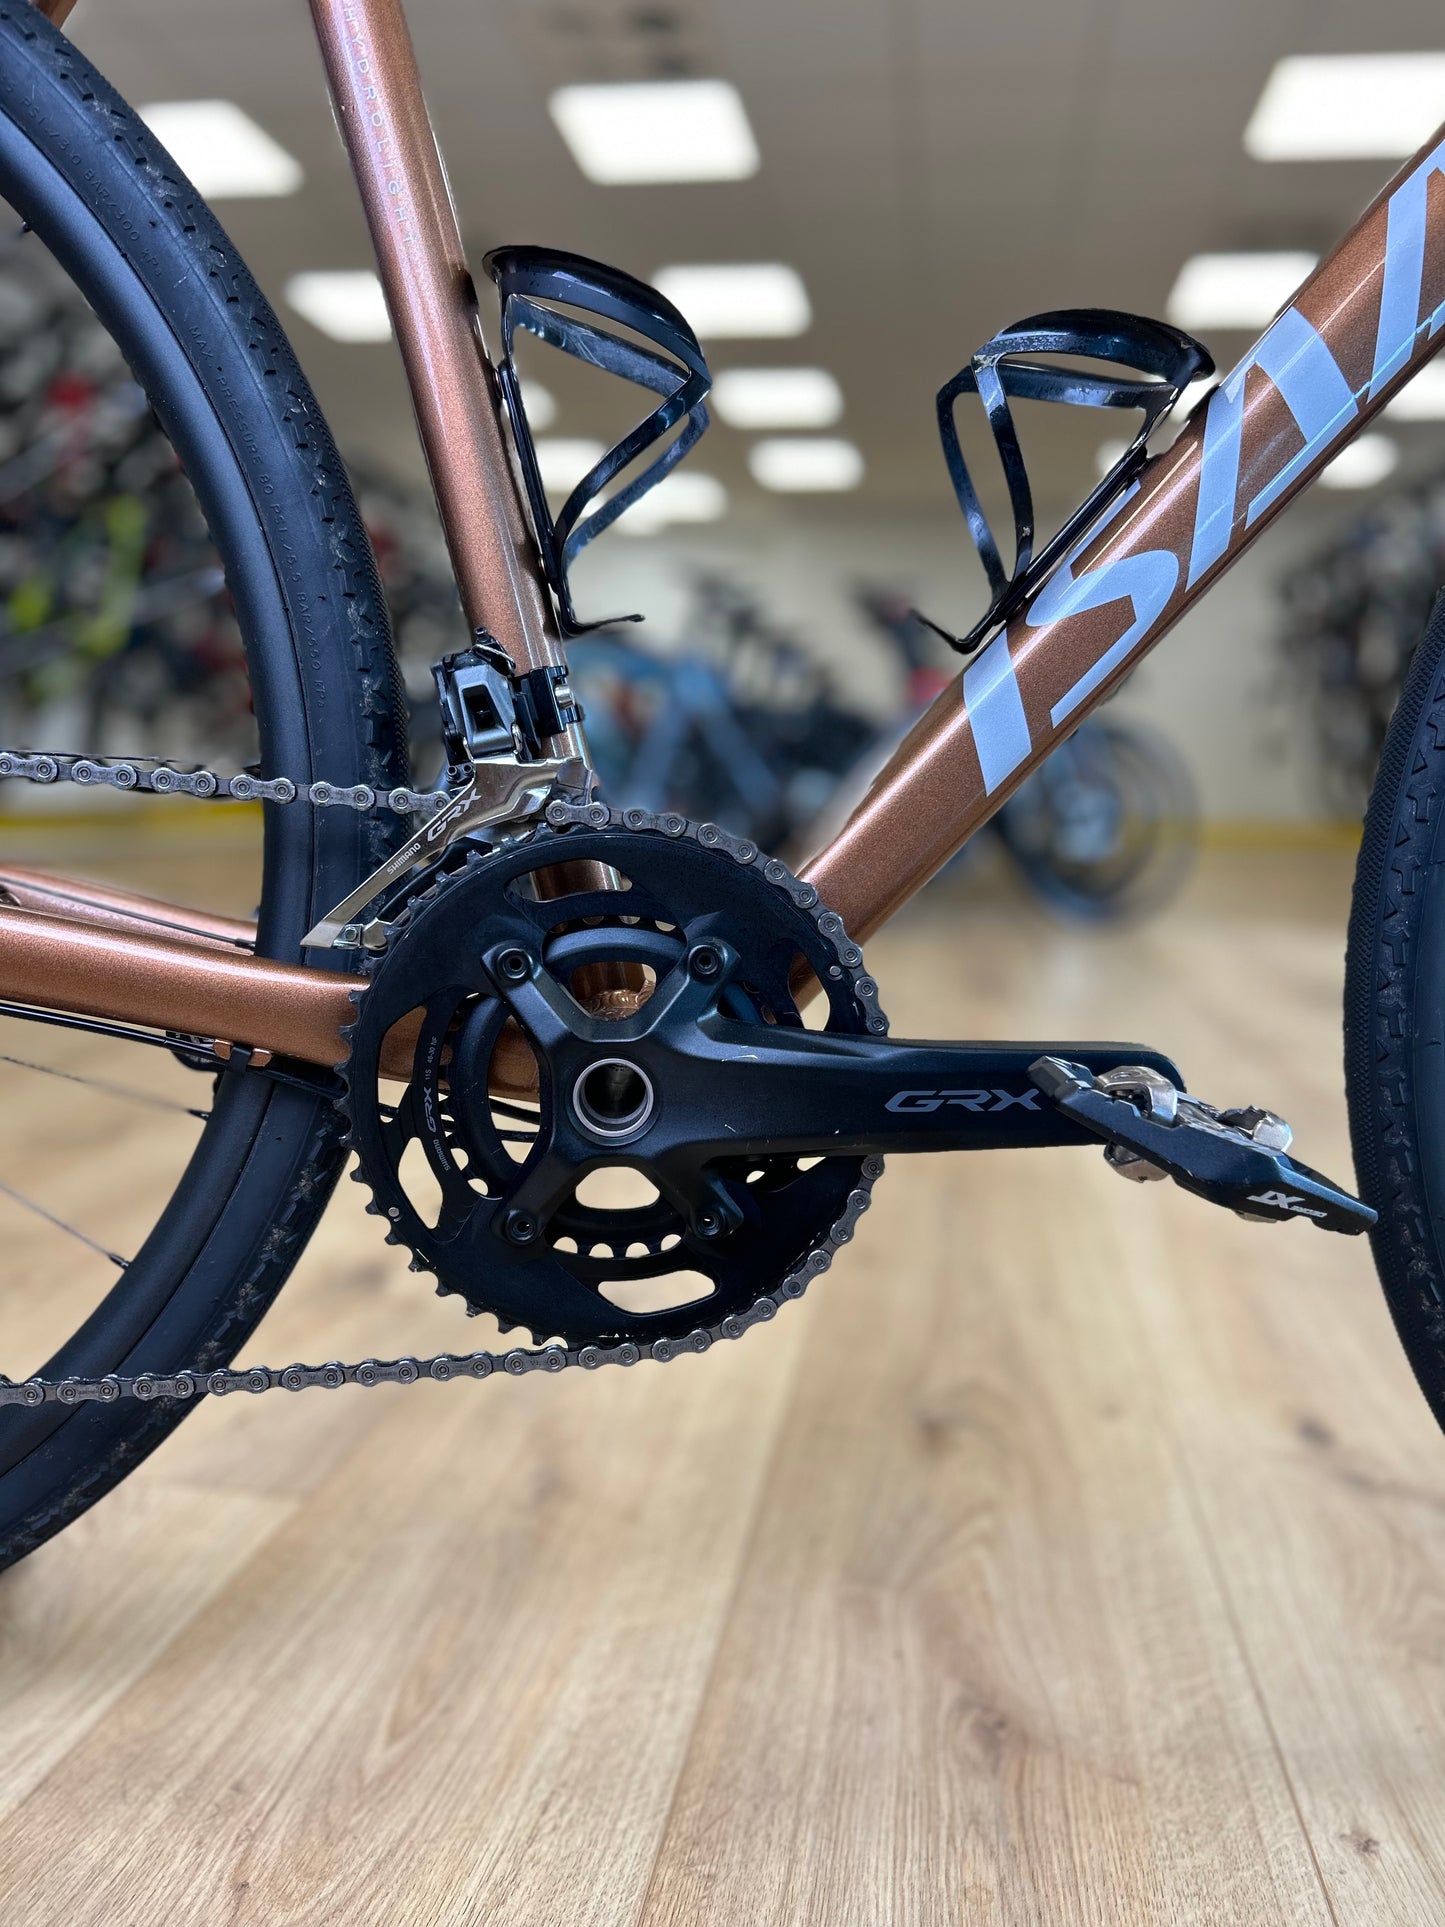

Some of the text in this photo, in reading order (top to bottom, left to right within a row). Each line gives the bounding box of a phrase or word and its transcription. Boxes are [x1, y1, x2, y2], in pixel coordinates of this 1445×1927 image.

[343, 7, 415, 245] HYDROLIGHT
[216, 375, 262, 466] PRESSURE
[387, 788, 481, 875] SHIMANO GRX
[424, 1087, 436, 1133] GRX
[884, 1088, 1042, 1112] GRX
[432, 1139, 450, 1171] SHIMANO
